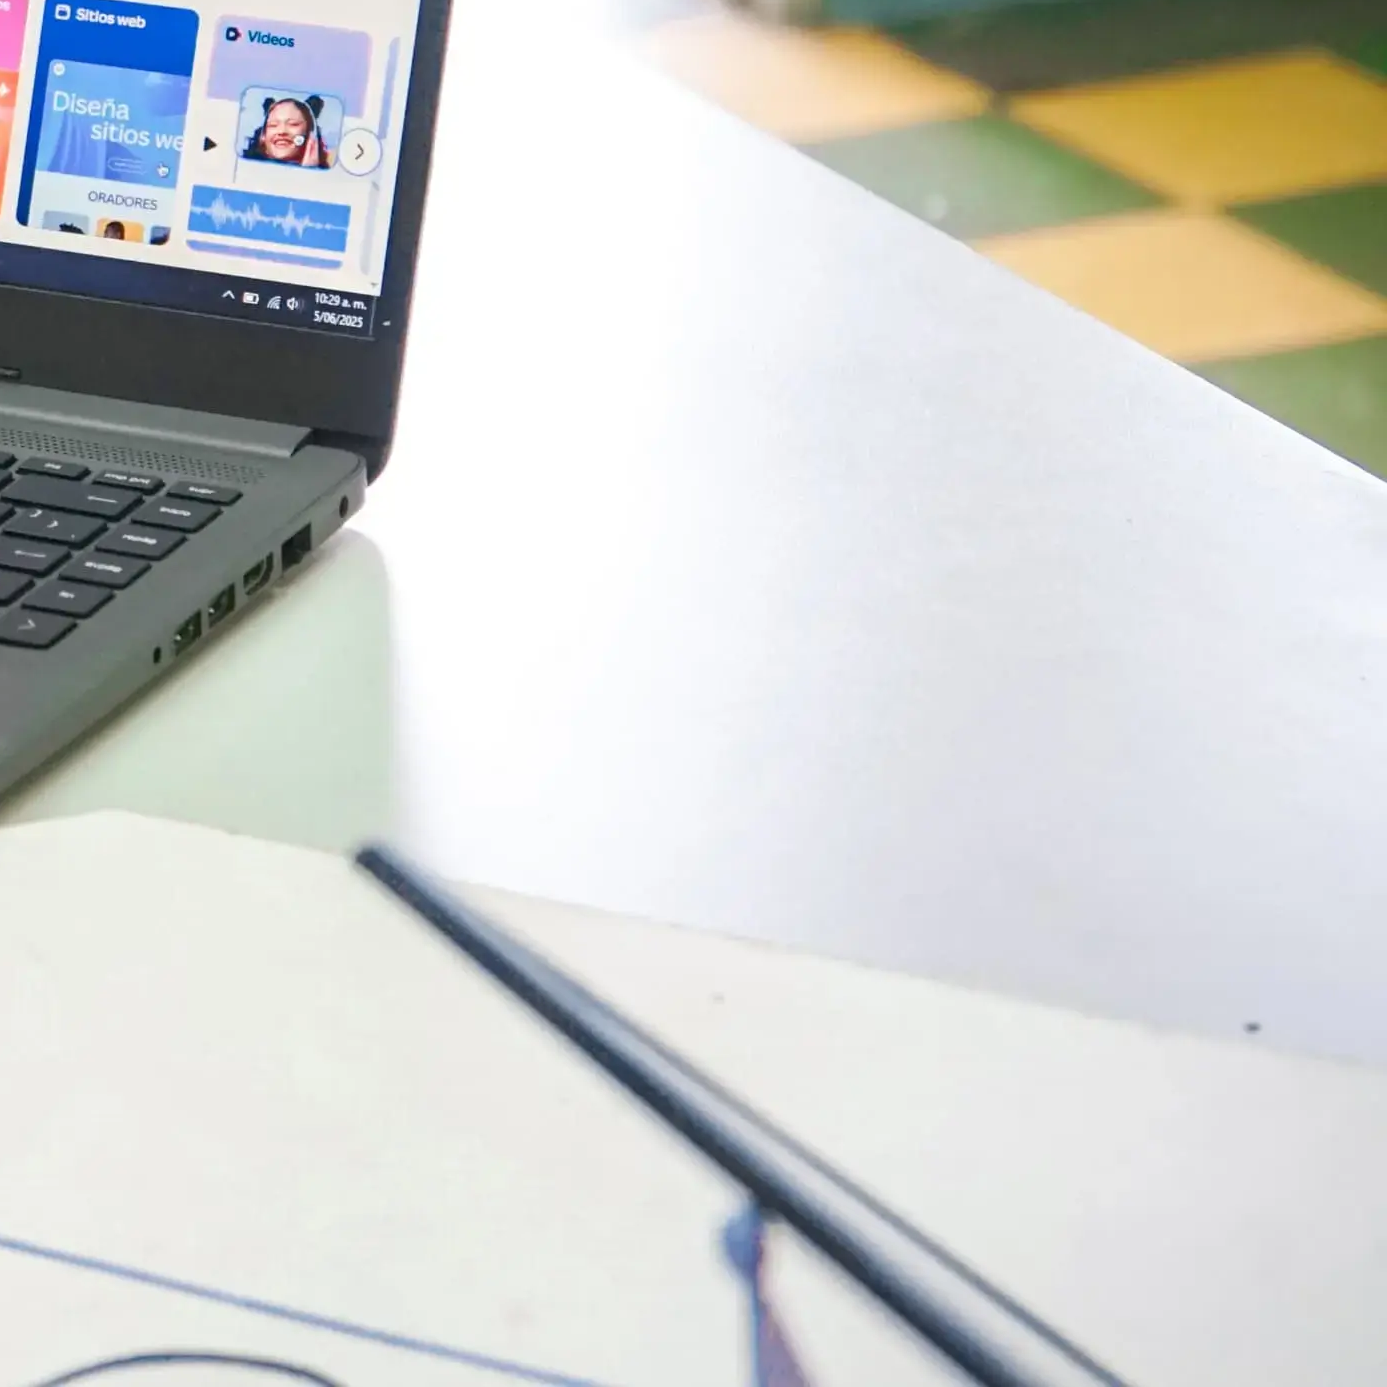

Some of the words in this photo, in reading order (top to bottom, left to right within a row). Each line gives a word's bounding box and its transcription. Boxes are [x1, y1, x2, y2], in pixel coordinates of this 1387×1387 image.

[75, 7, 115, 26] Sitios
[117, 12, 147, 29] web
[247, 29, 295, 48] Videos
[52, 89, 130, 122] Diseña
[90, 121, 150, 147] sitios
[88, 190, 158, 211] ORADORES
[314, 292, 340, 307] 10:29
[341, 299, 352, 309] a.
[353, 300, 368, 311] m.
[313, 310, 364, 328] 5/06/2025
